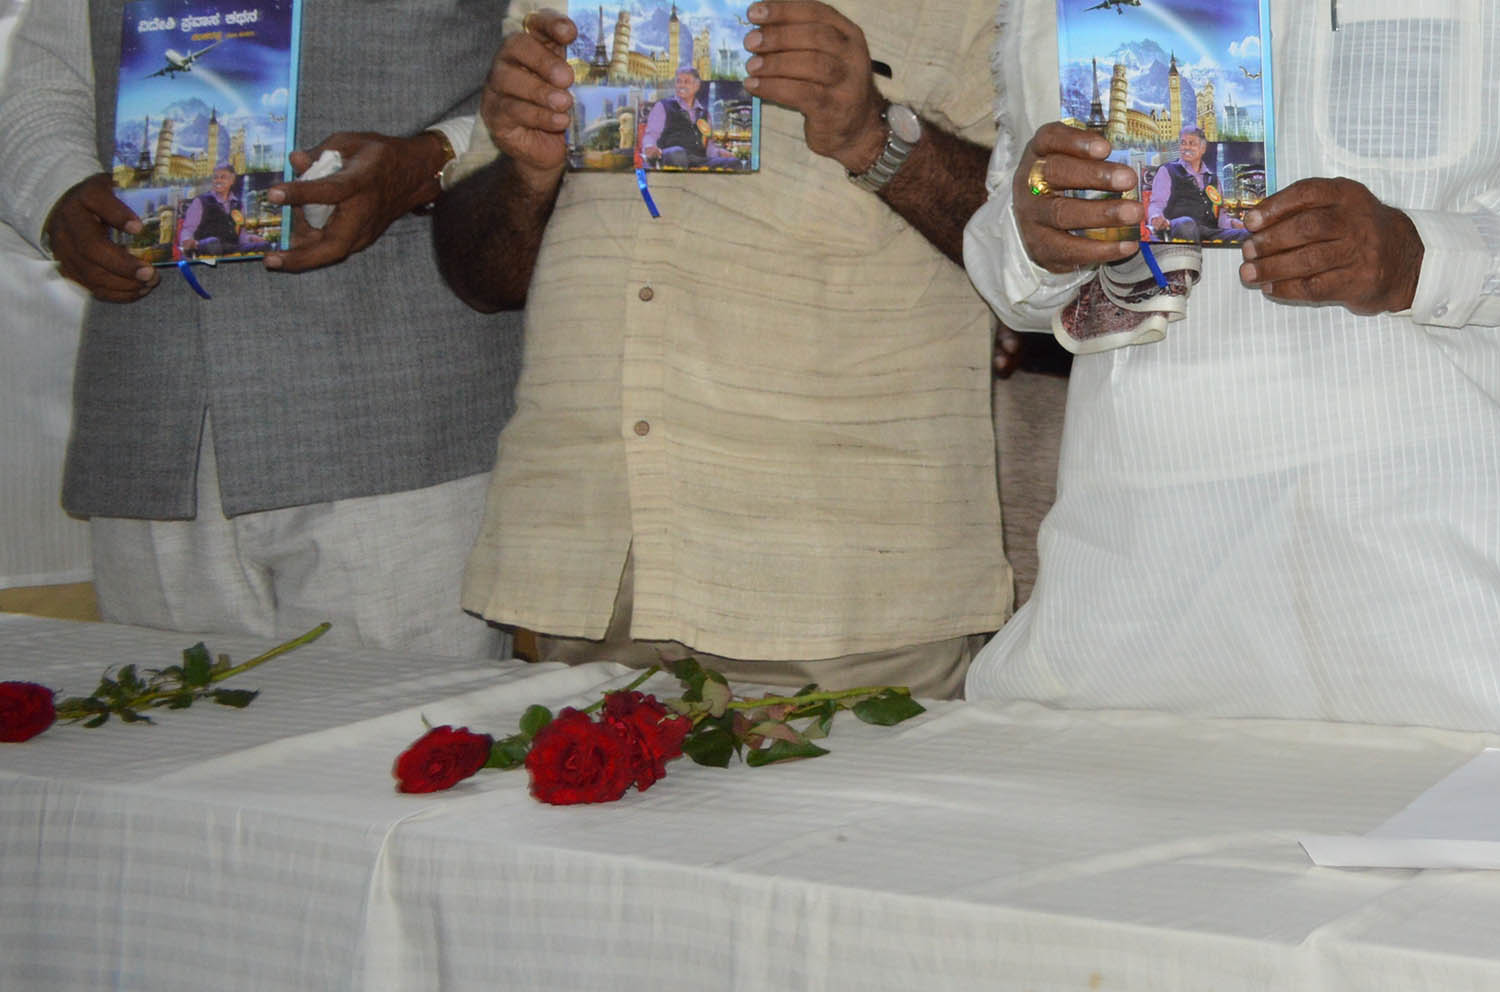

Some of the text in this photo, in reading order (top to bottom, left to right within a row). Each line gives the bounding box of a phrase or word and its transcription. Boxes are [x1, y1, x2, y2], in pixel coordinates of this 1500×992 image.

[137, 8, 258, 33] ವಿದೇಶಿ ಪ್ರವಾಸ ಕಥನ
